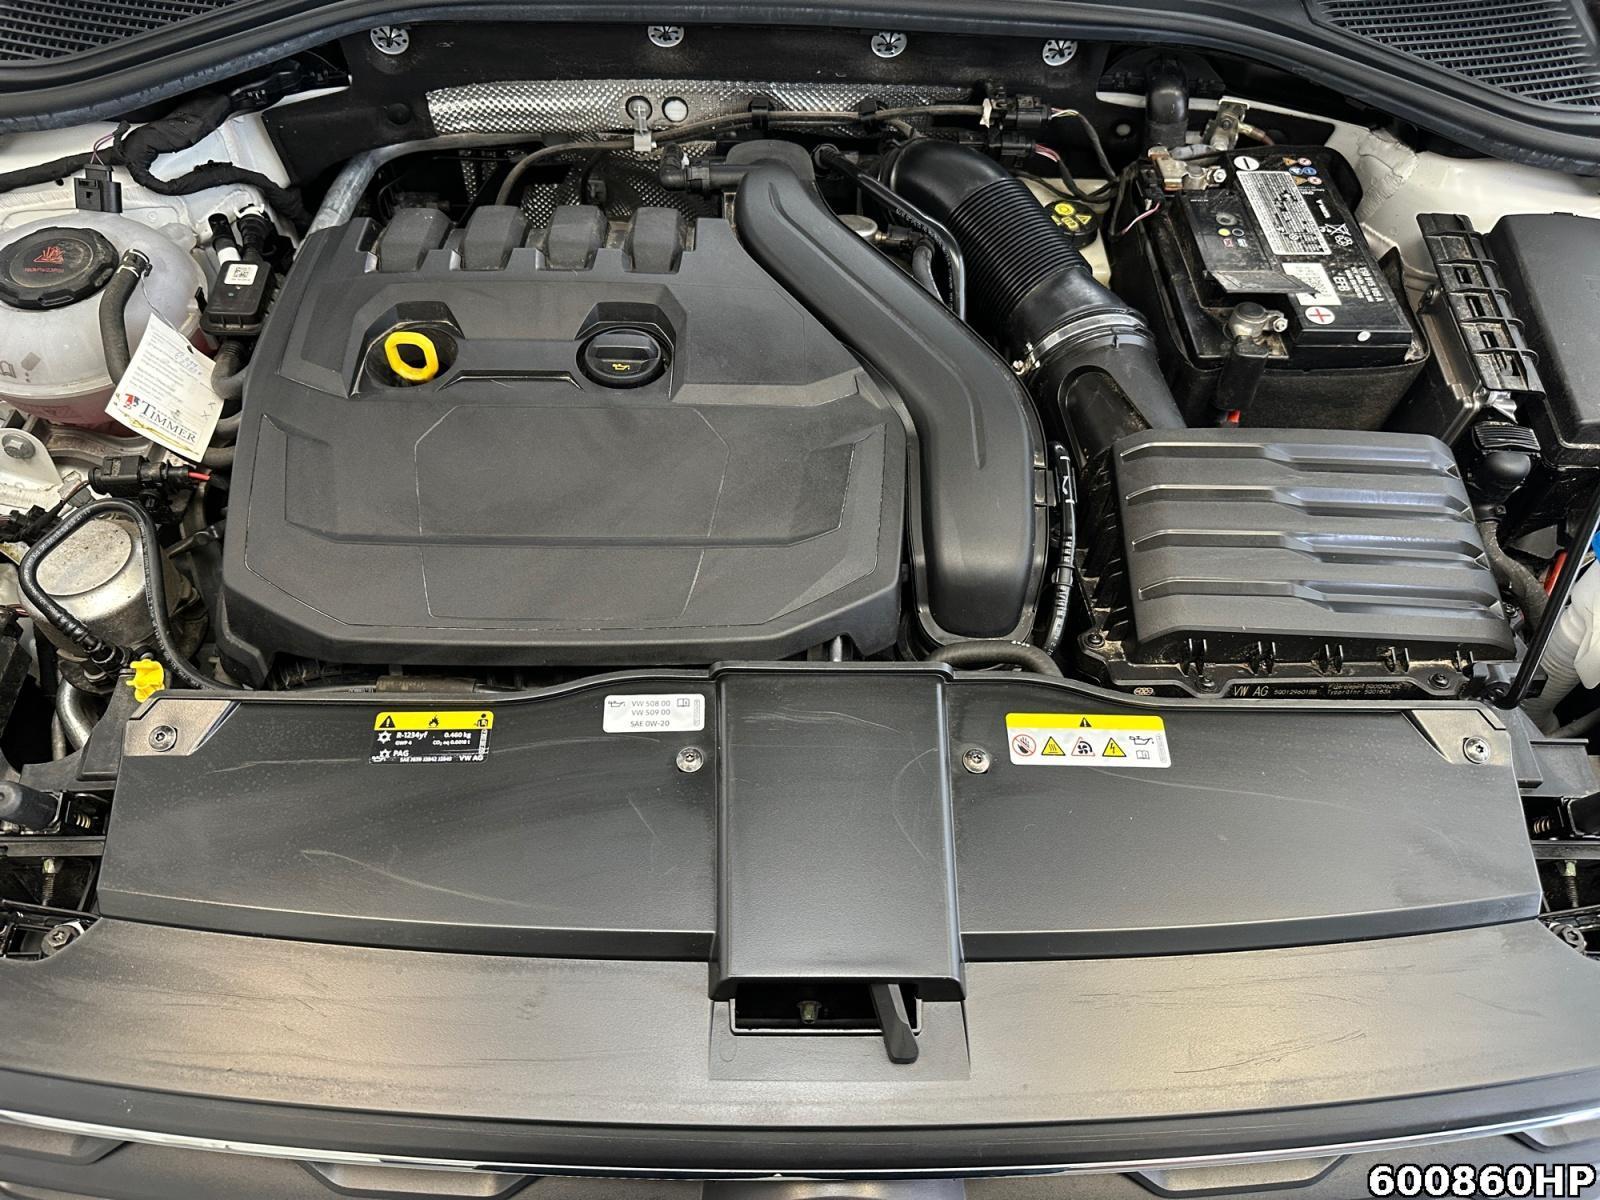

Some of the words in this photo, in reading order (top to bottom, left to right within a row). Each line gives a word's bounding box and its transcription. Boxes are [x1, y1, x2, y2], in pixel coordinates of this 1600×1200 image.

[1333, 276, 1351, 292] EFB
[141, 399, 197, 443] TIMMER
[1234, 685, 1249, 697] VW
[1252, 685, 1269, 697] AG
[396, 731, 428, 740] R-1234yf
[463, 731, 472, 740] kg
